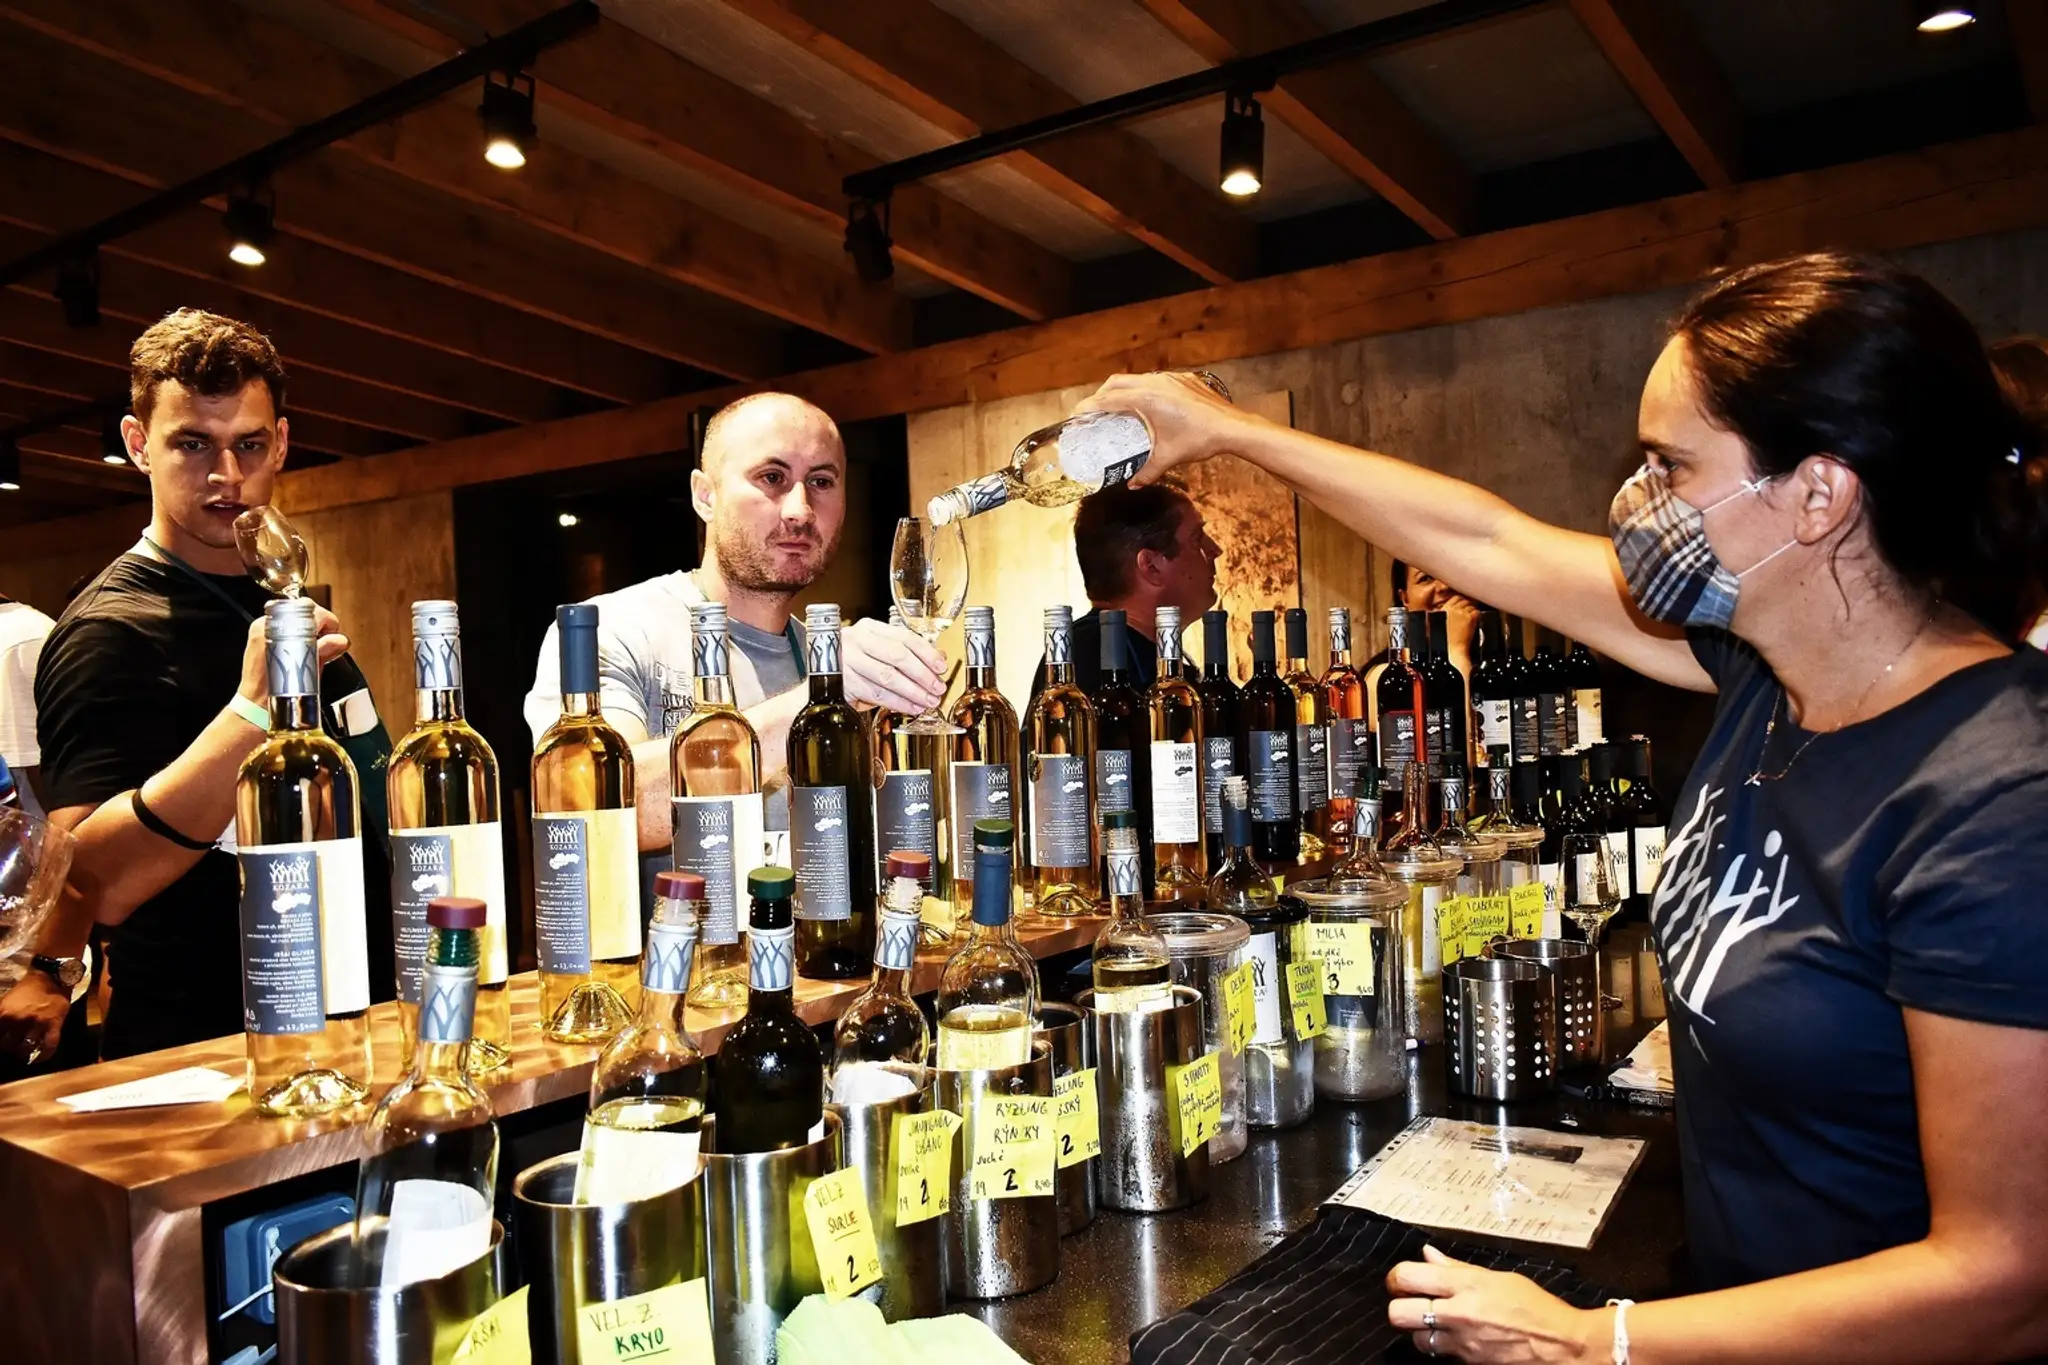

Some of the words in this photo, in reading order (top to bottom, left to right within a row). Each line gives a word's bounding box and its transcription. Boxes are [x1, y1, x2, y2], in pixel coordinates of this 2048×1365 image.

[549, 842, 580, 850] KOZARA
[411, 864, 445, 872] KOZARA
[271, 882, 311, 892] KOZARA
[1316, 927, 1347, 940] MILIA
[1326, 973, 1340, 991] 3
[1306, 1013, 1315, 1031] 2
[1061, 1133, 1075, 1156] 2
[974, 1180, 987, 1197] 19
[1002, 1168, 1019, 1192] 2
[920, 1178, 931, 1206] 2
[846, 1254, 860, 1284] 2
[614, 1327, 664, 1355] KRYO
